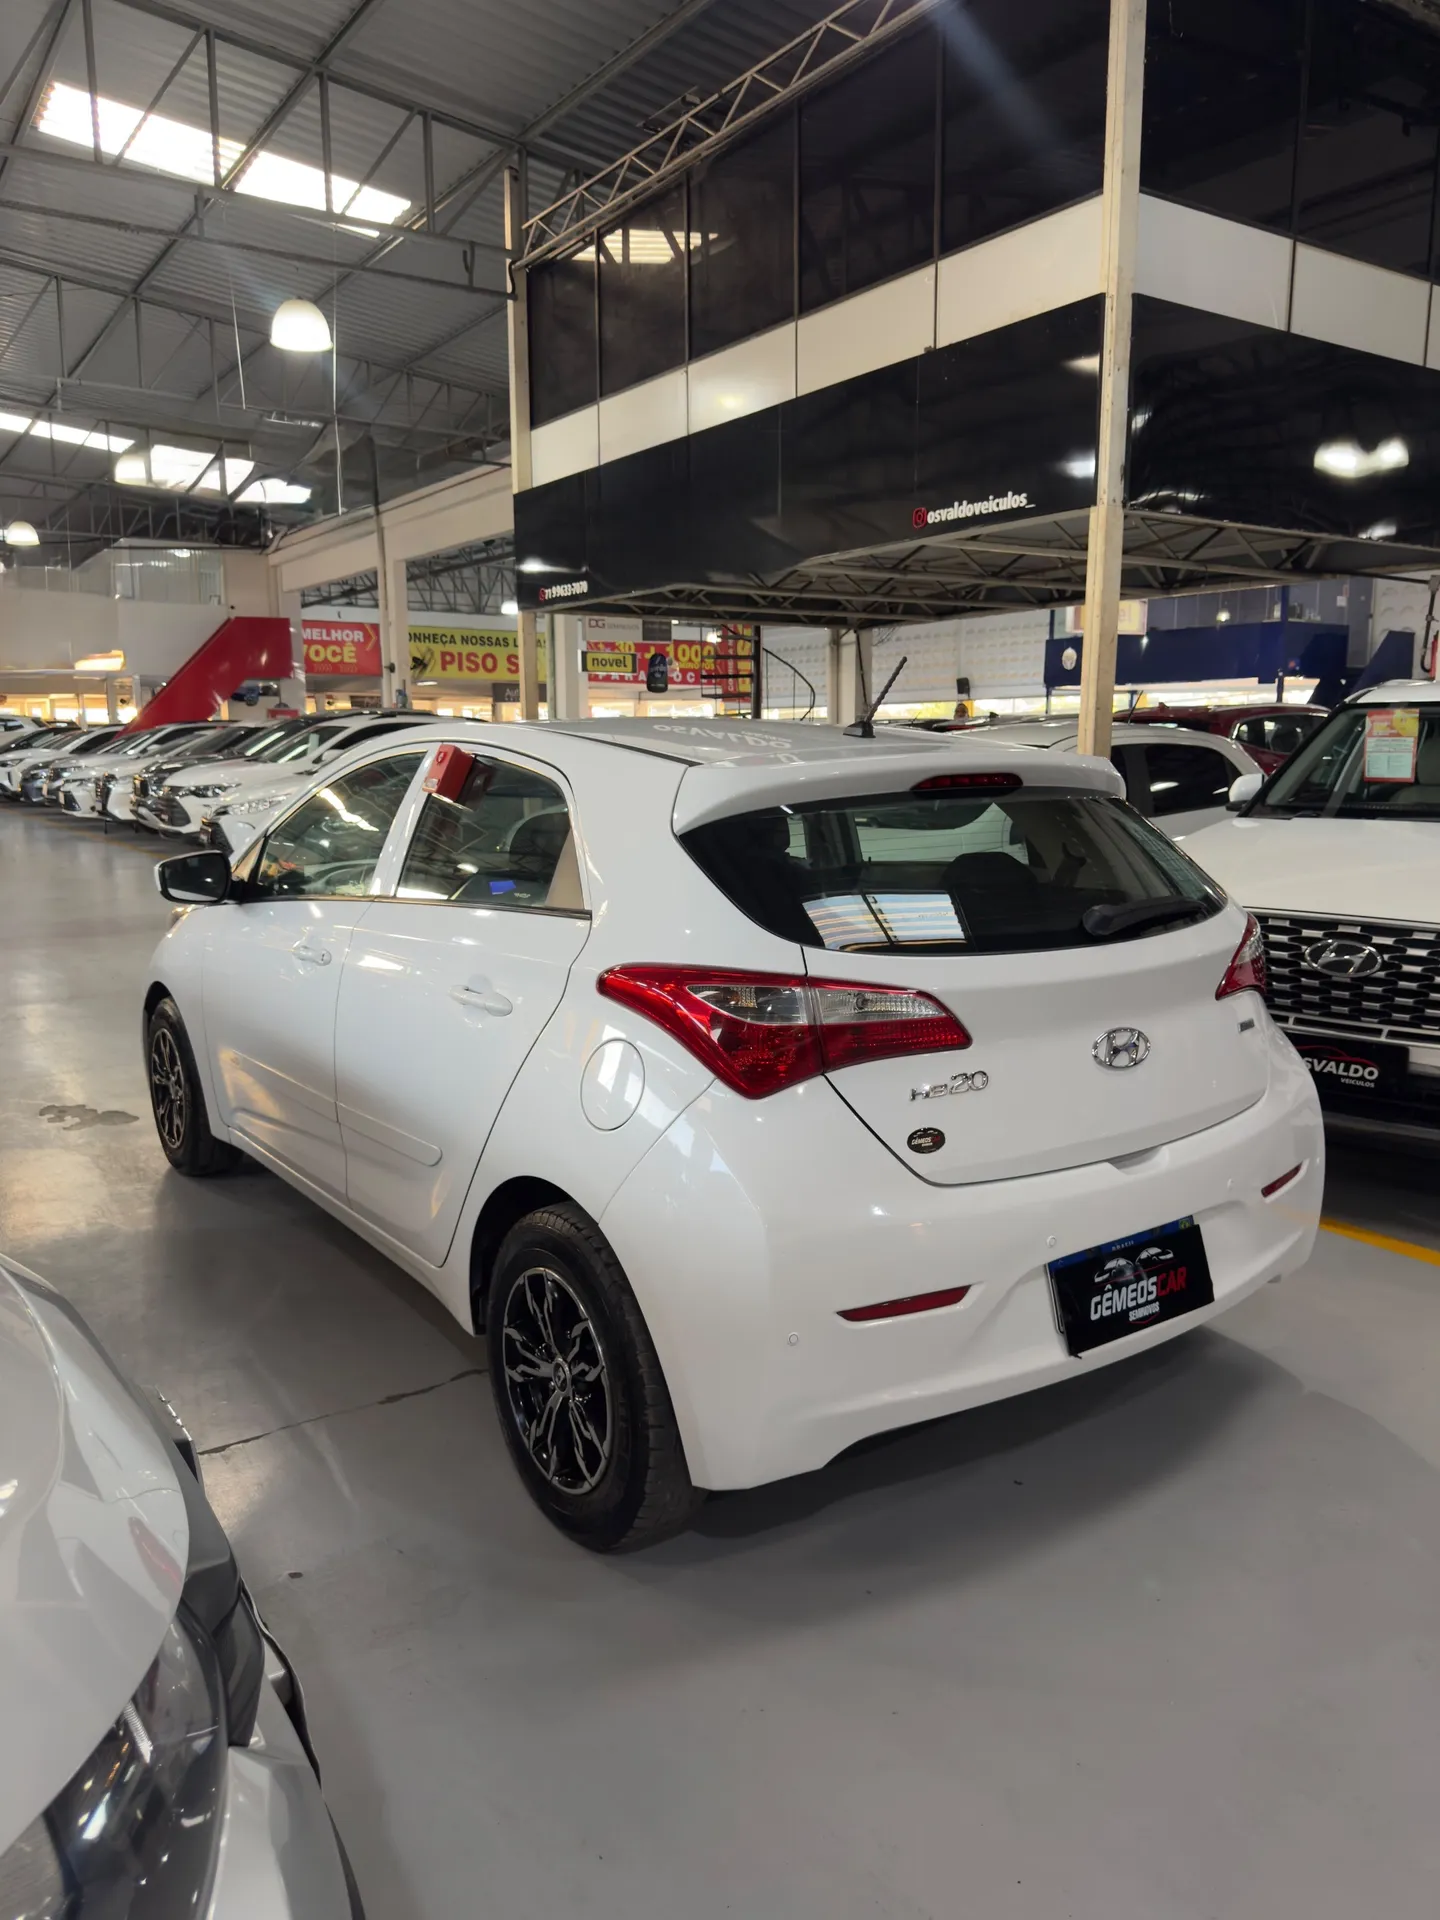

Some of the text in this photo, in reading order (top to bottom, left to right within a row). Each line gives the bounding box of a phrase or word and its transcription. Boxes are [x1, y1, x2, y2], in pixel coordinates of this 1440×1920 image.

[927, 491, 1036, 524] osvaldoveiculos_
[545, 580, 588, 600] 71 99633-7070
[303, 627, 364, 643] MELHOR
[409, 632, 457, 648] NHEÇA
[460, 634, 509, 648] NOSSAS
[440, 650, 519, 675] PISO S
[591, 656, 627, 668] novel
[1303, 1057, 1380, 1081] SVALDO
[909, 1070, 989, 1102] HB20
[1340, 1077, 1376, 1089] VEICULOS
[1128, 1301, 1160, 1322] SEMINOVOS
